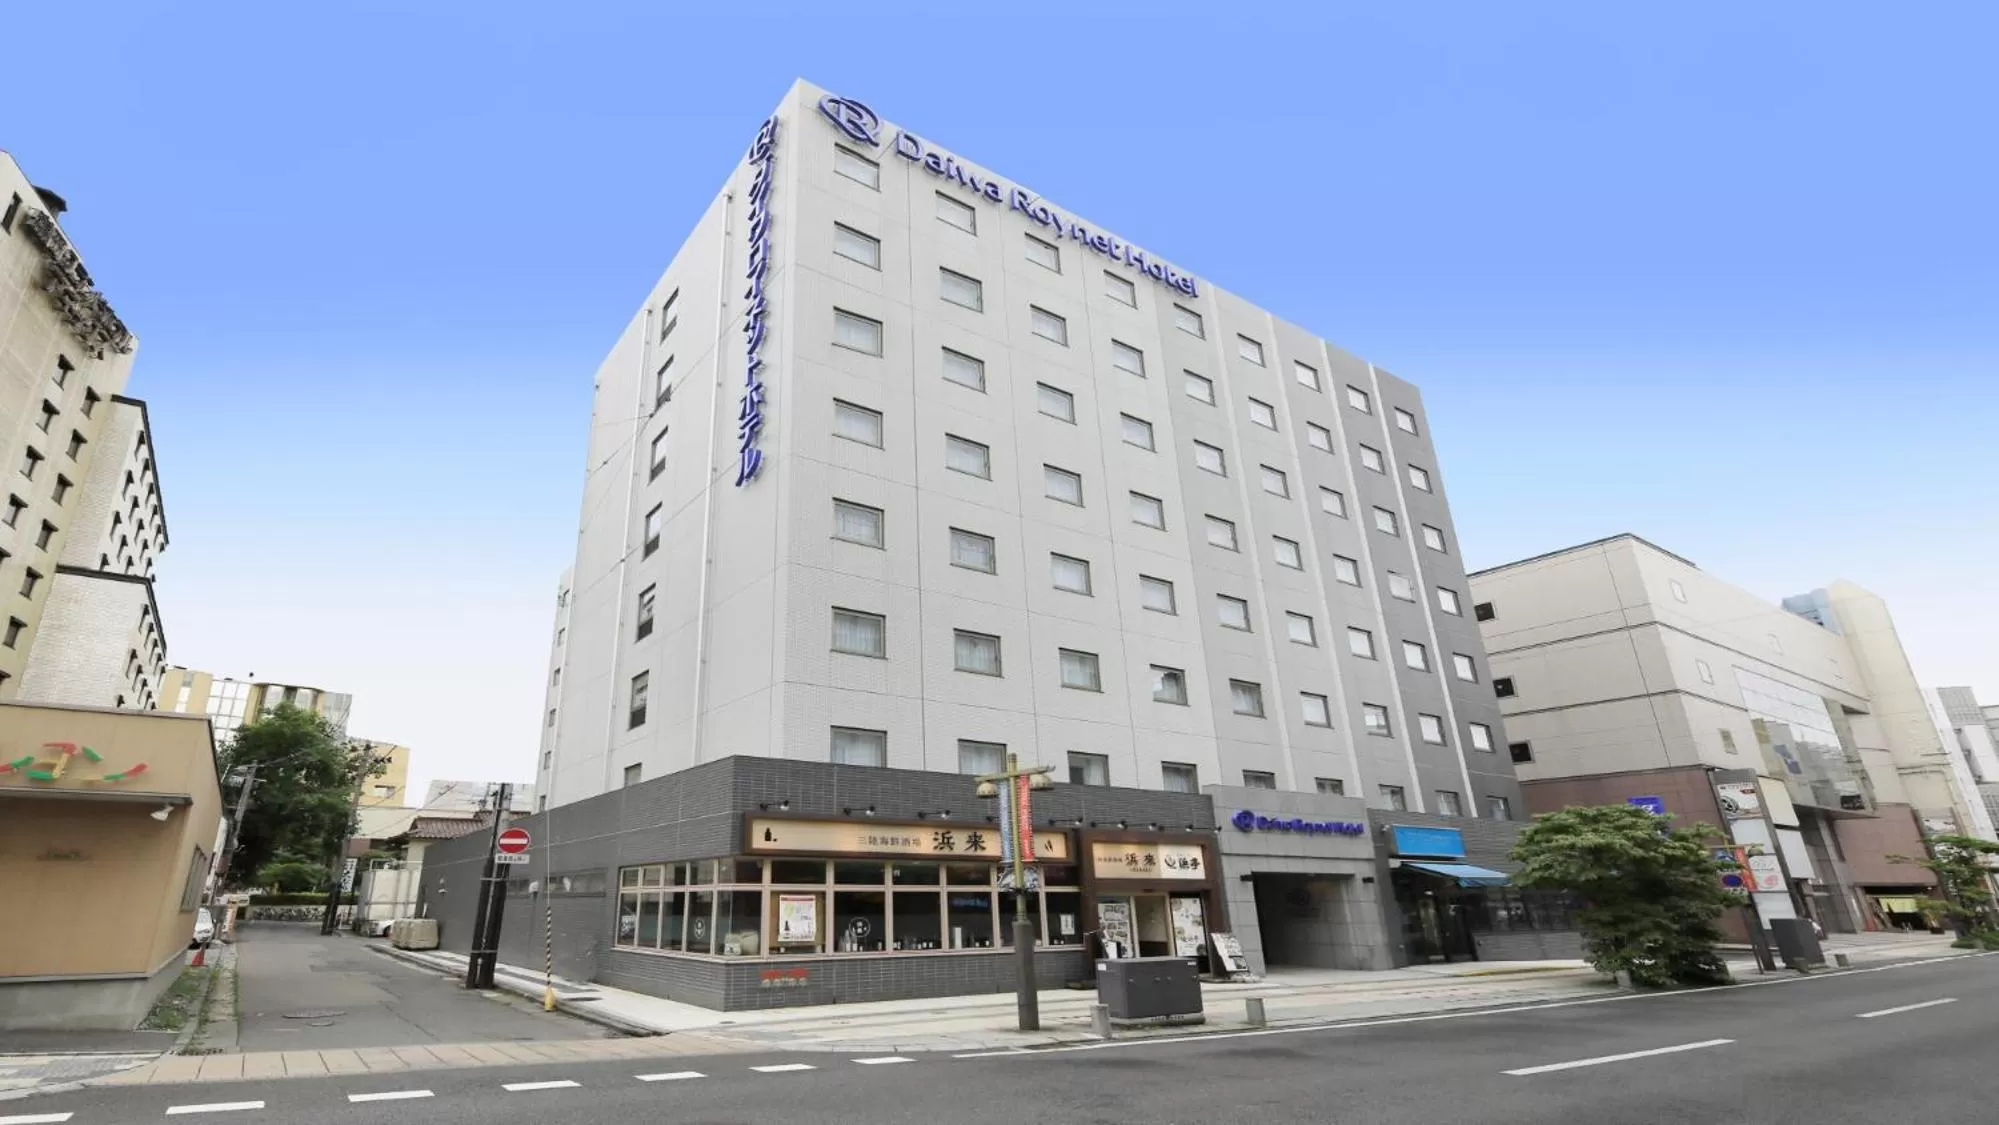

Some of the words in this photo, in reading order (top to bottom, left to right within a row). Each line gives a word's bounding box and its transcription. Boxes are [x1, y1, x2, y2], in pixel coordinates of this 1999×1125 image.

[896, 130, 1003, 203] Daiwa
[1010, 187, 1121, 261] Roynet
[1125, 244, 1199, 298] Hotel
[932, 829, 987, 851] 浜来
